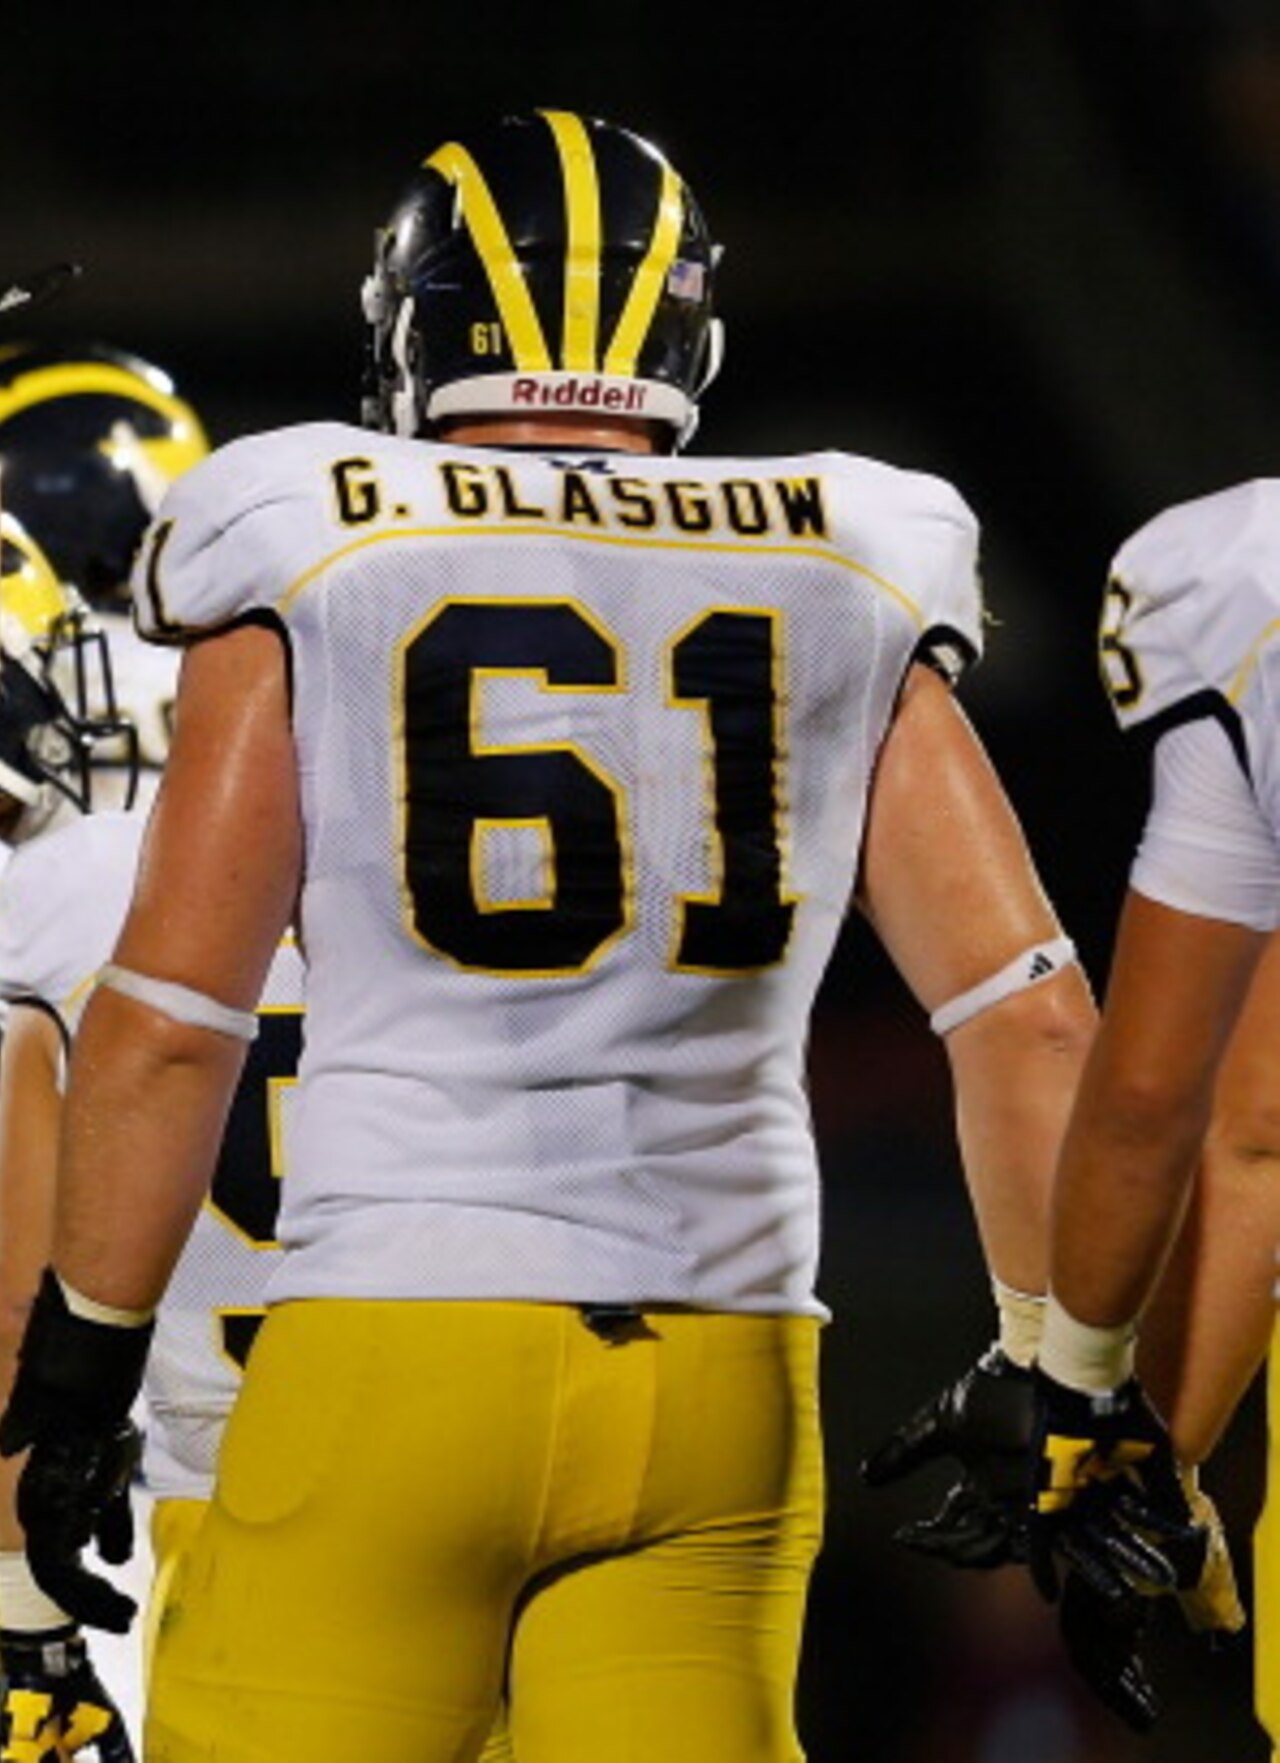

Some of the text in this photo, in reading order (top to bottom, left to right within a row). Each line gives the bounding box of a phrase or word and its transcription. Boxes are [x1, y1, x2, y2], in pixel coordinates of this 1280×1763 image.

[472, 322, 502, 355] 61
[511, 378, 647, 411] Riddell
[331, 457, 831, 540] G. GLASGOW
[391, 595, 805, 979] 61
